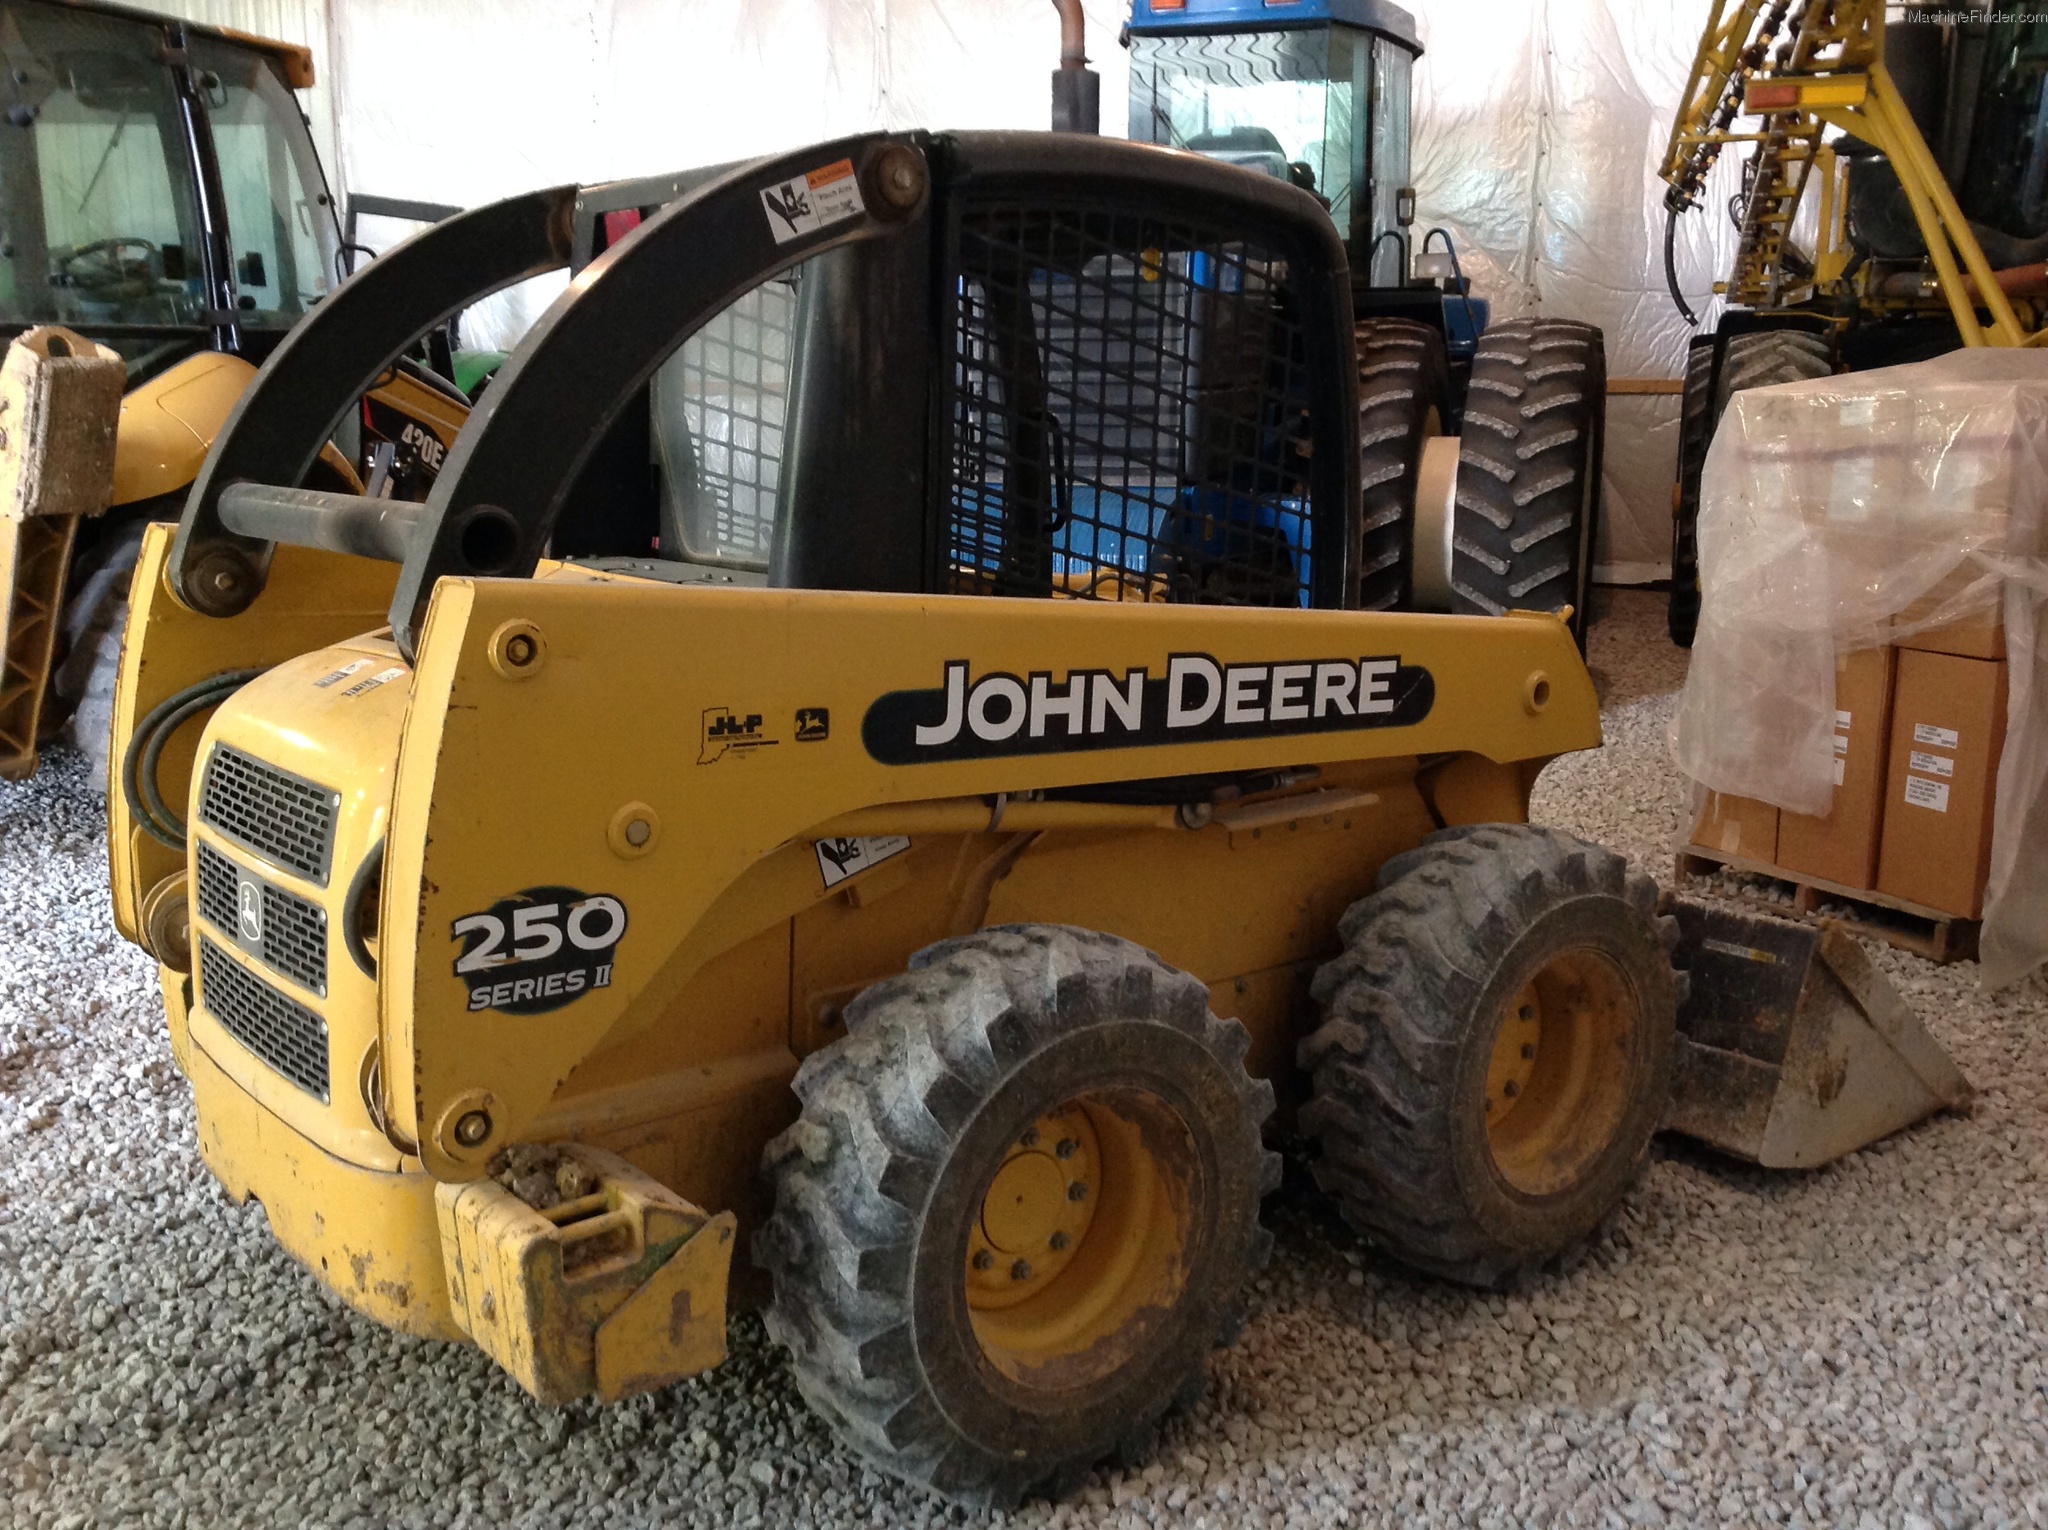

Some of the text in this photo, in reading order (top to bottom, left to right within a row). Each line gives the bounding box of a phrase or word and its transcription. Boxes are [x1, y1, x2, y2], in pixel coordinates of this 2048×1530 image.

[915, 657, 1399, 746] JOHN DEERE
[455, 896, 626, 973] 250
[469, 964, 612, 1010] SERIES II
